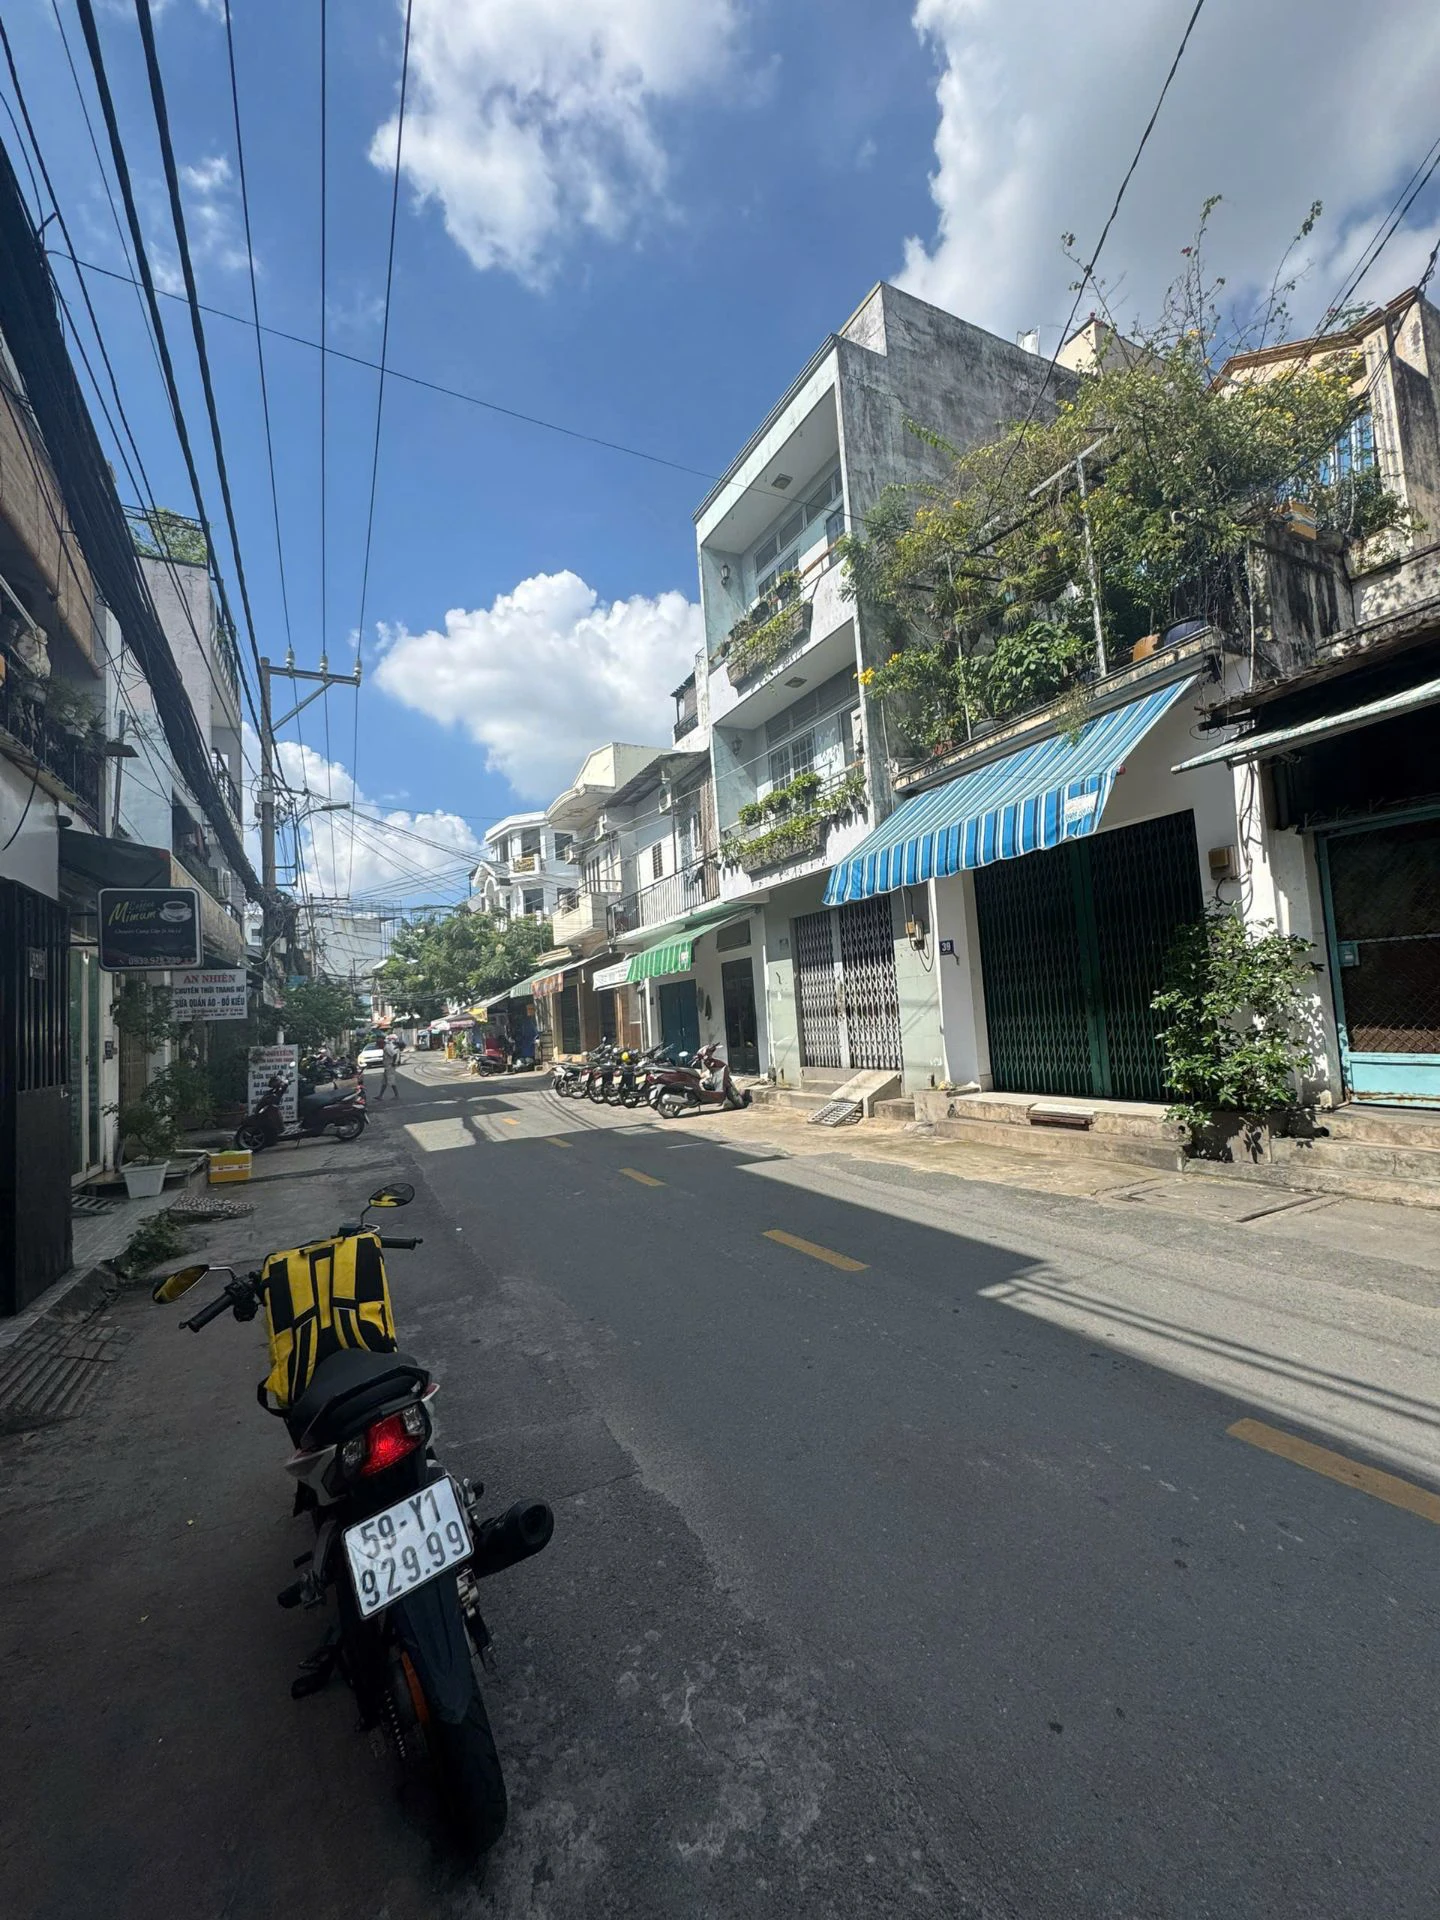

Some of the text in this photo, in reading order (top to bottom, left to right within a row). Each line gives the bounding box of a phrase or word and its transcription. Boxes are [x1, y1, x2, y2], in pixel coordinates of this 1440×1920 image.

[941, 942, 951, 952] 39
[184, 972, 236, 984] AN NHIÊN
[207, 996, 216, 1007] ÁO
[359, 1489, 441, 1559] 59-Y1
[361, 1520, 465, 1607] 929.99
